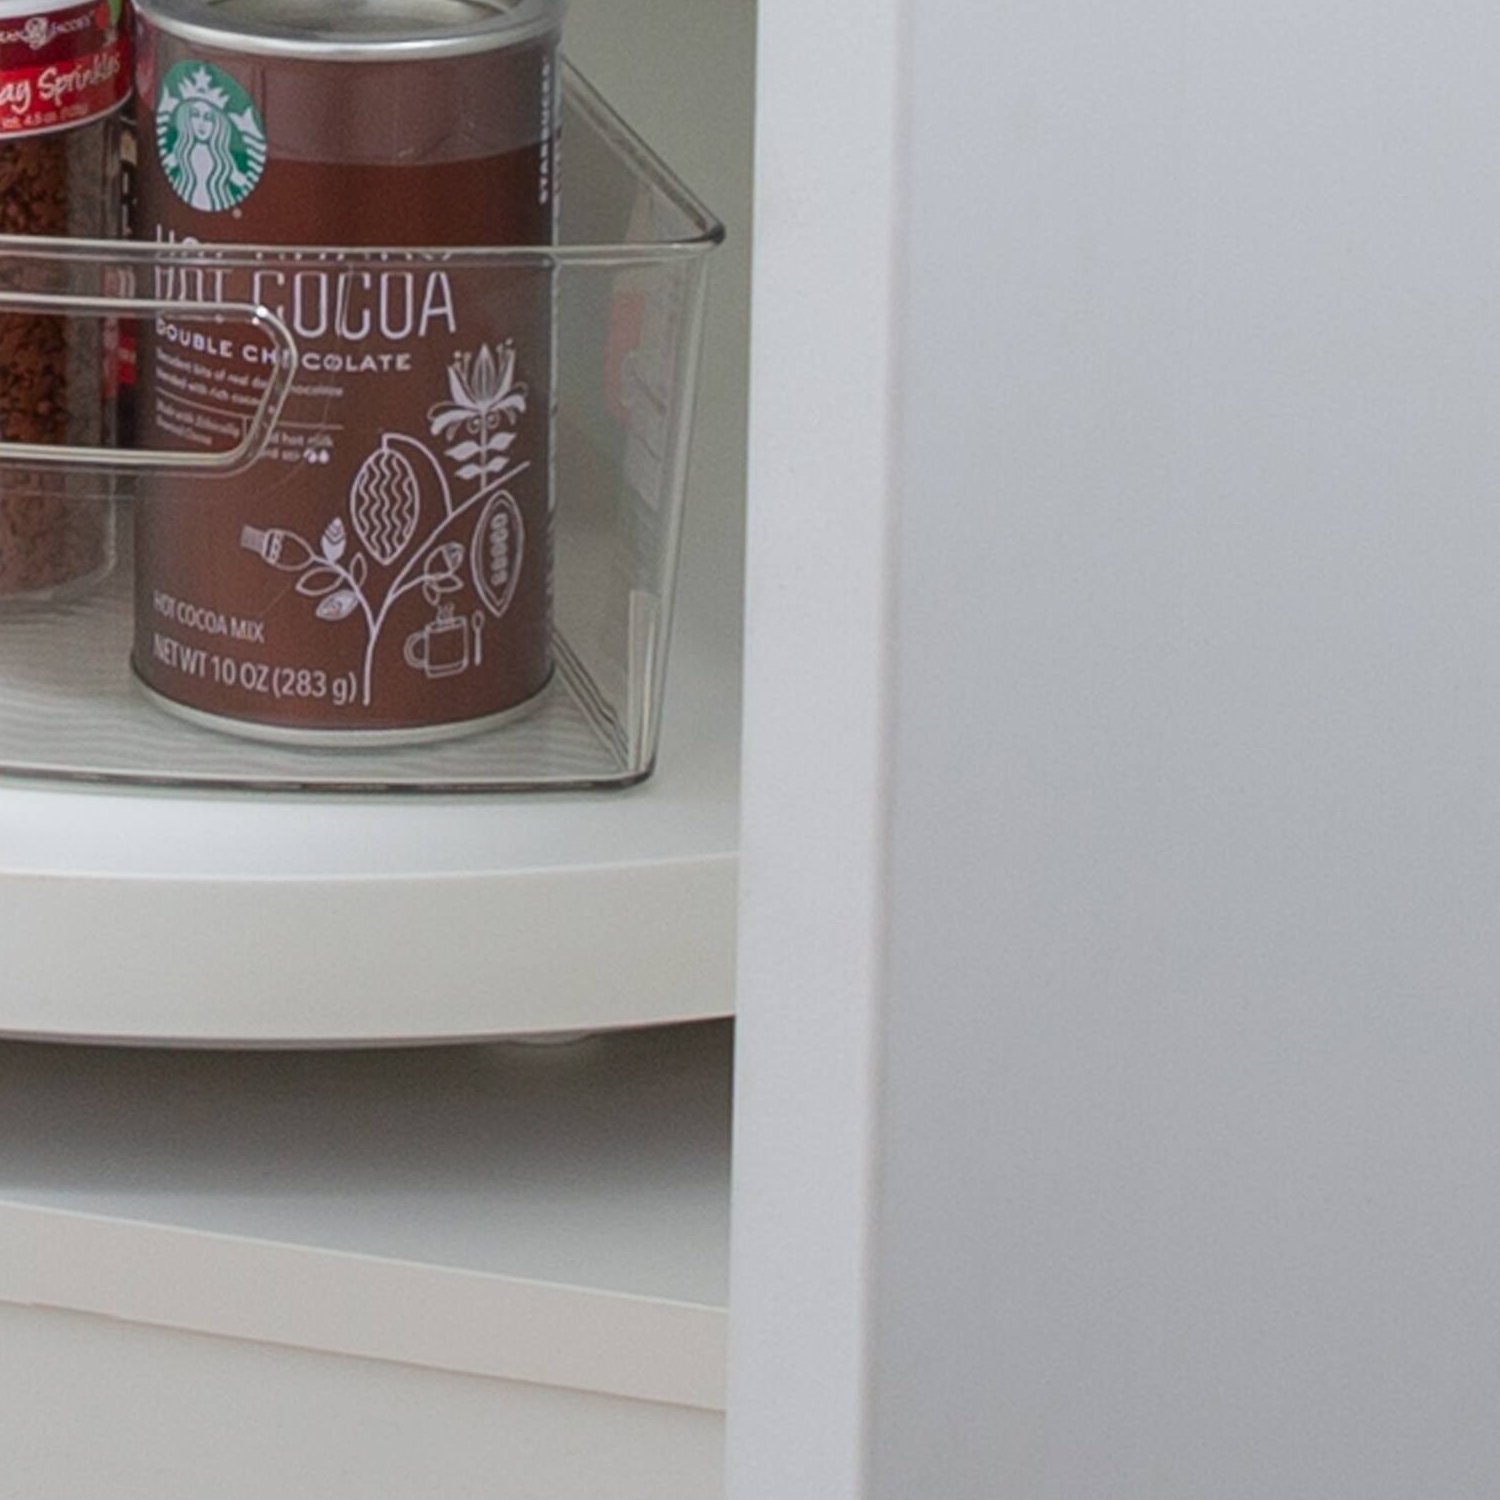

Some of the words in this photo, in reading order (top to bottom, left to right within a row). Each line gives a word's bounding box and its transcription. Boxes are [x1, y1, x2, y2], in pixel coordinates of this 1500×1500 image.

[37, 51, 122, 105] Sprinkles
[252, 255, 458, 341] COCOA
[155, 320, 233, 358] DOUBLE
[242, 344, 413, 373] CHCOLATE
[153, 590, 176, 619] HOT
[176, 602, 228, 636] COCOA
[230, 616, 265, 645] MIX
[153, 632, 180, 667] NET
[180, 646, 208, 679] WT
[211, 654, 237, 686] 10
[239, 662, 270, 694] OZ
[272, 666, 327, 700] (283
[332, 671, 358, 707] g)
